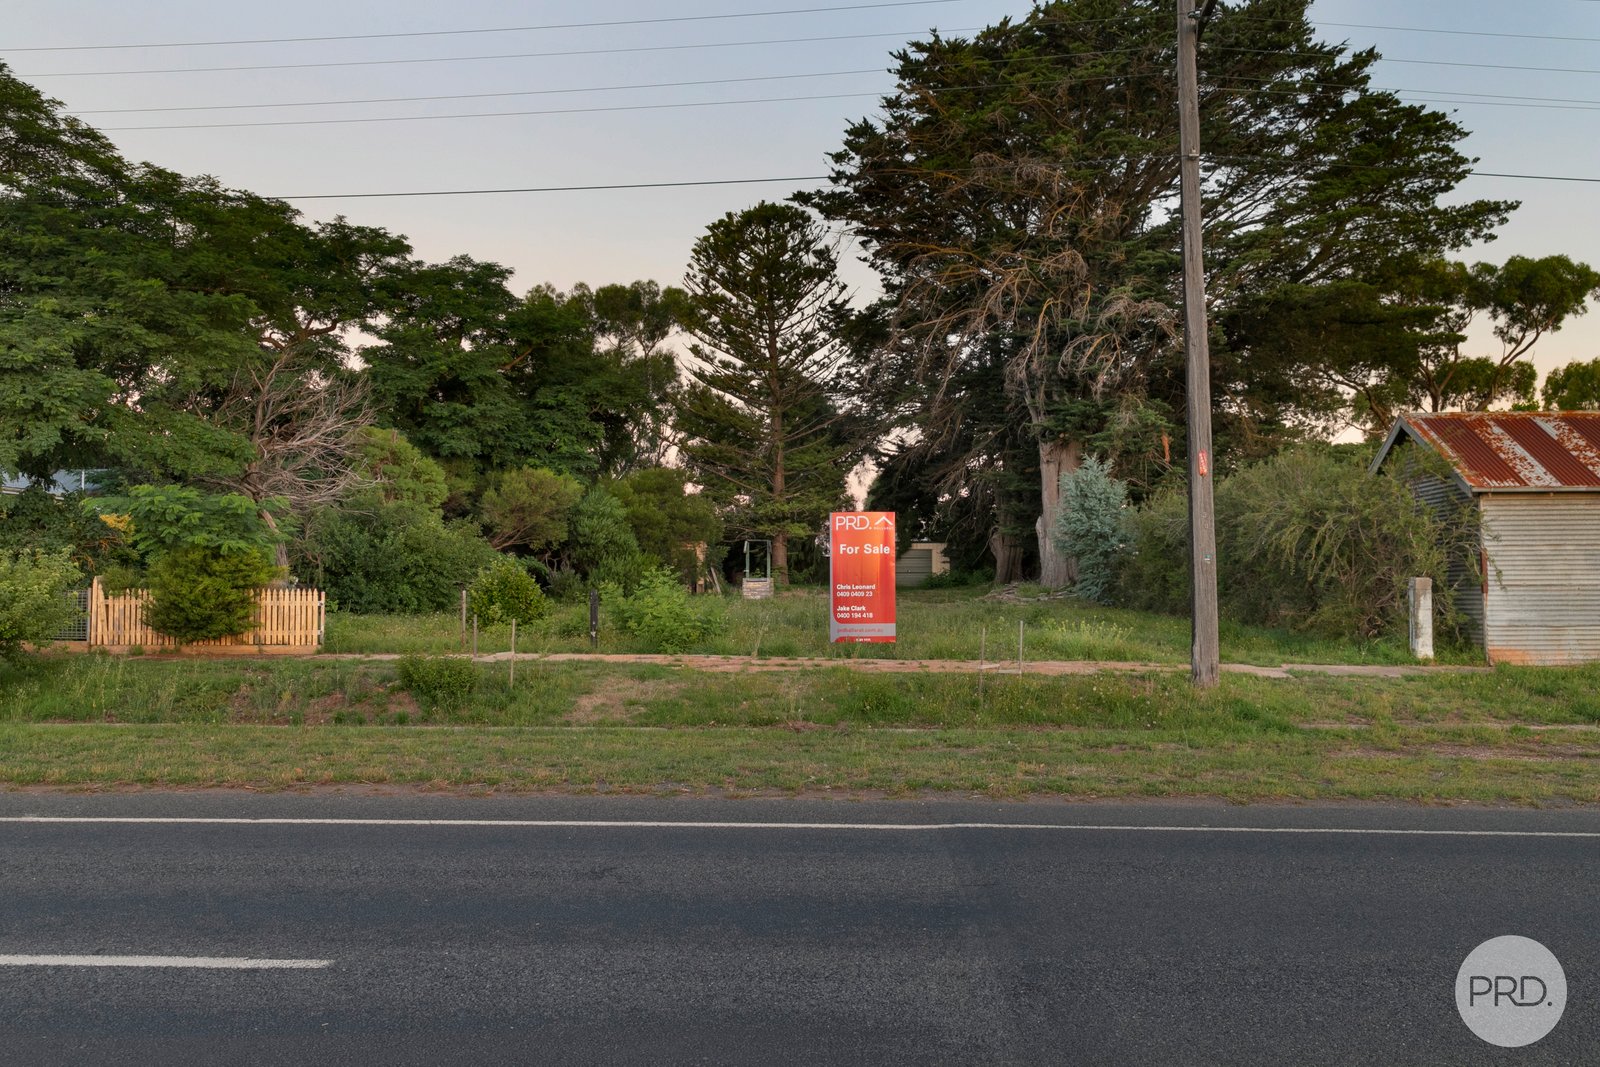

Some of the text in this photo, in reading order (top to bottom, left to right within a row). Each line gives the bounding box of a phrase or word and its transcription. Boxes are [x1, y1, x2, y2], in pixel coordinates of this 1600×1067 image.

[835, 515, 872, 531] PRD.
[839, 543, 891, 555] For Sale
